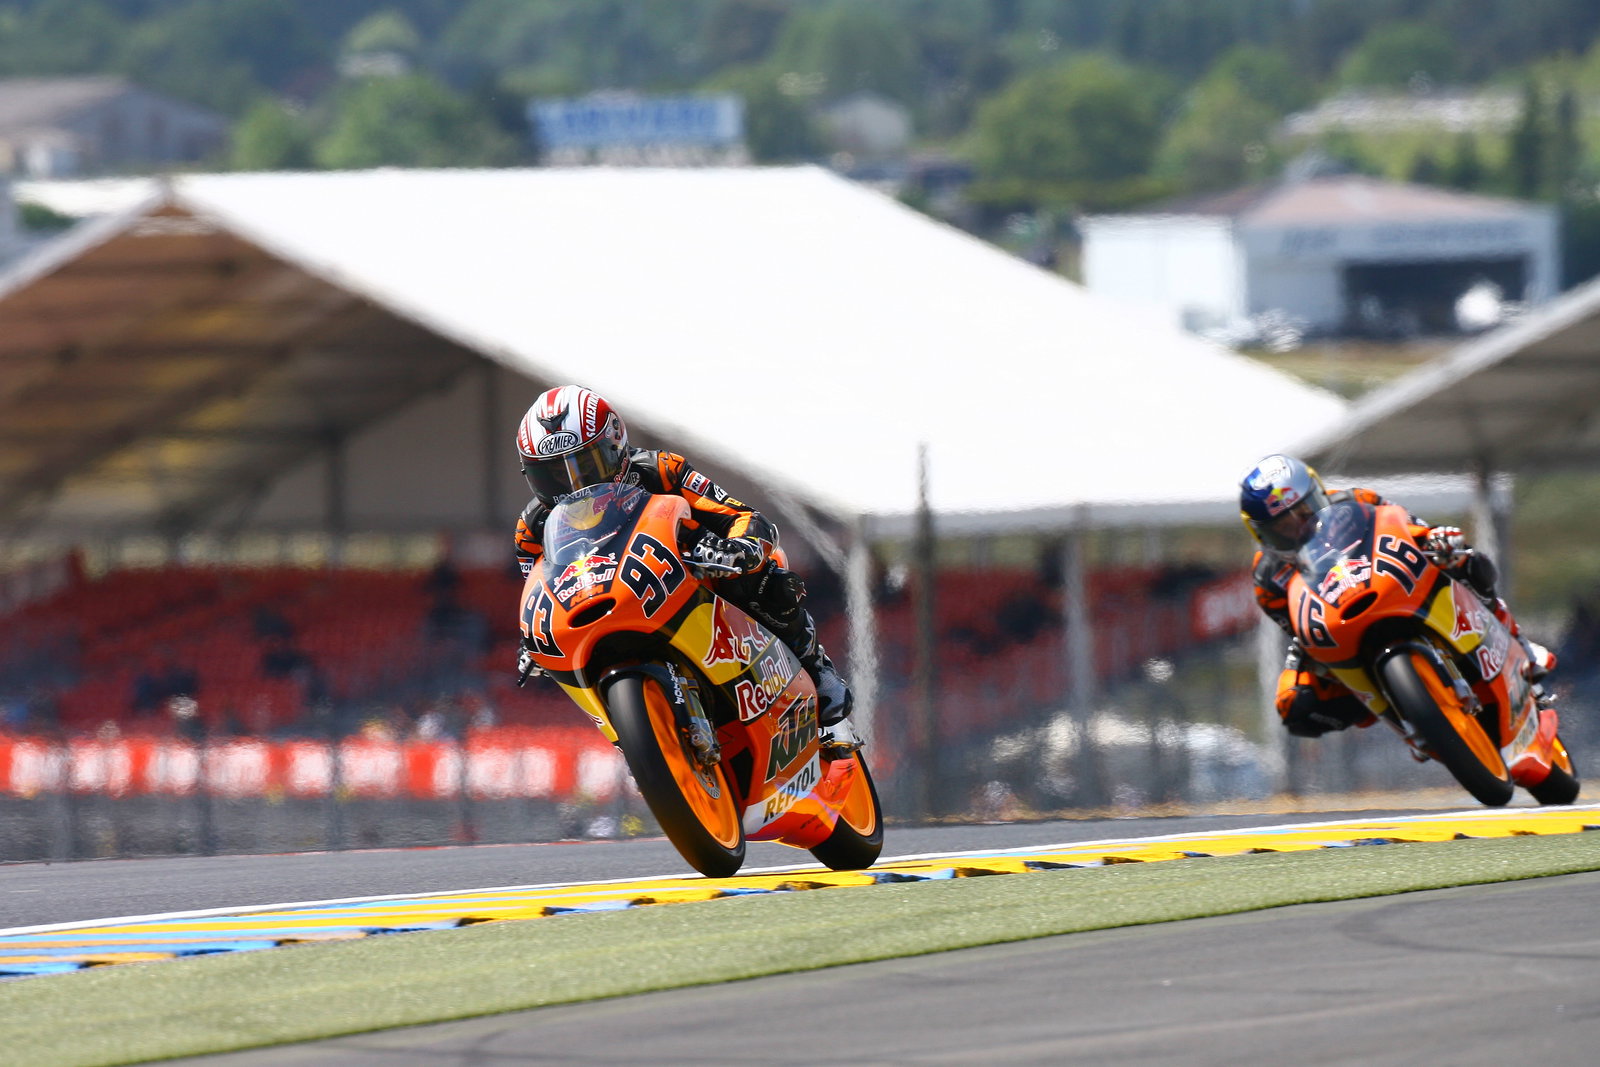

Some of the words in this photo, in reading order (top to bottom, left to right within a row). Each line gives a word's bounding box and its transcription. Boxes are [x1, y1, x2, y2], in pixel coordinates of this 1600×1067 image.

[541, 436, 574, 454] PREMIER
[619, 532, 686, 619] 93
[1374, 534, 1428, 597] 16
[1297, 586, 1340, 648] 16
[735, 659, 776, 721] Red
[764, 638, 793, 696] Bull
[764, 692, 818, 784] KTM
[763, 761, 815, 824] REPSOL
